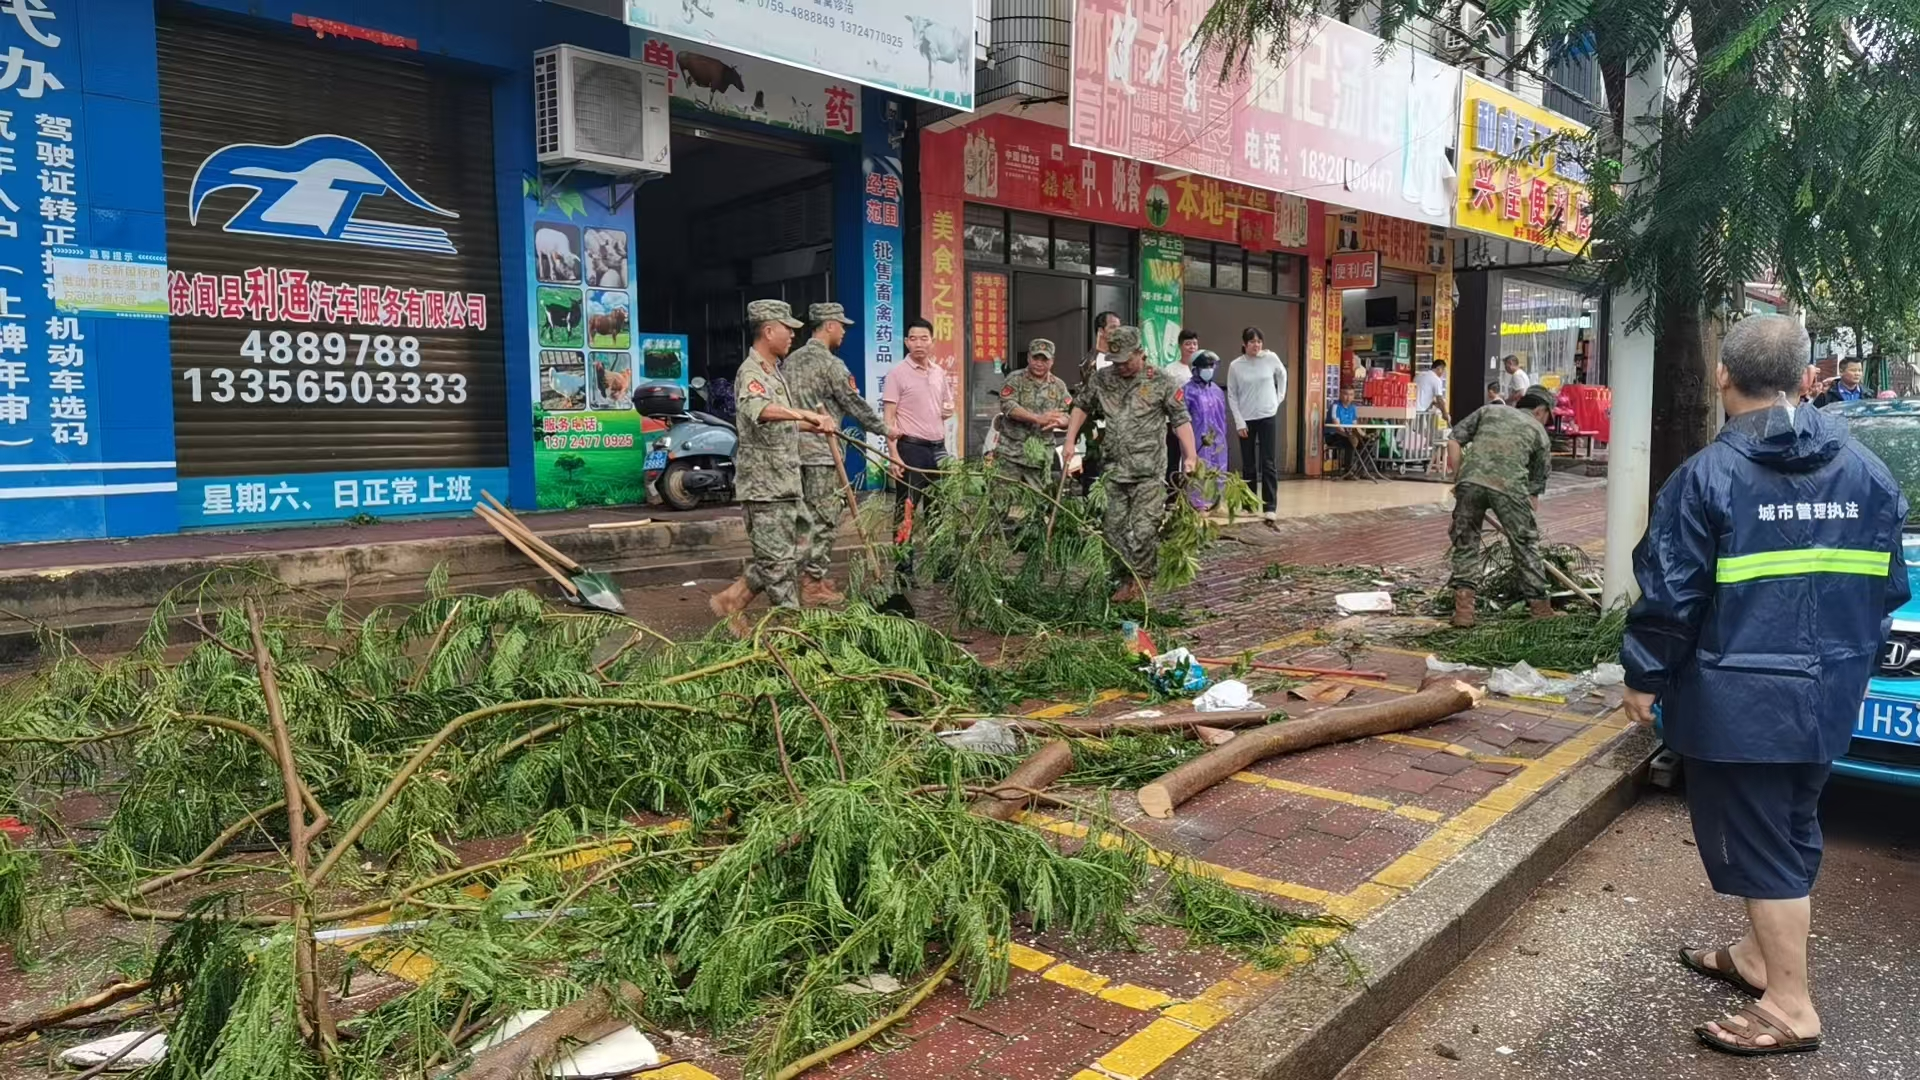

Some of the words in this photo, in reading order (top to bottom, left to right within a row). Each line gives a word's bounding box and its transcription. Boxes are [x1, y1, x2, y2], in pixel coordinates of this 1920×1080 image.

[840, 20, 903, 48] 13724770925
[824, 85, 854, 132] 药
[866, 173, 898, 199] 经营
[1300, 148, 1394, 195] 1832098447
[866, 199, 899, 227] 范围
[1335, 261, 1374, 279] 便利店
[167, 266, 487, 331] 徐闻县利通汽车服务有限公司
[874, 240, 893, 363] 批售畜禽药品
[1310, 266, 1324, 361] 家的味道
[240, 330, 421, 368] 4889788
[183, 367, 468, 405] 13356503333
[543, 417, 603, 432] 服务电话：
[544, 435, 567, 449] 137
[569, 435, 600, 448] 2477
[603, 434, 633, 448] 0925
[202, 475, 473, 515] 星期六、日正常上班
[1758, 501, 1859, 521] 城市管理执法
